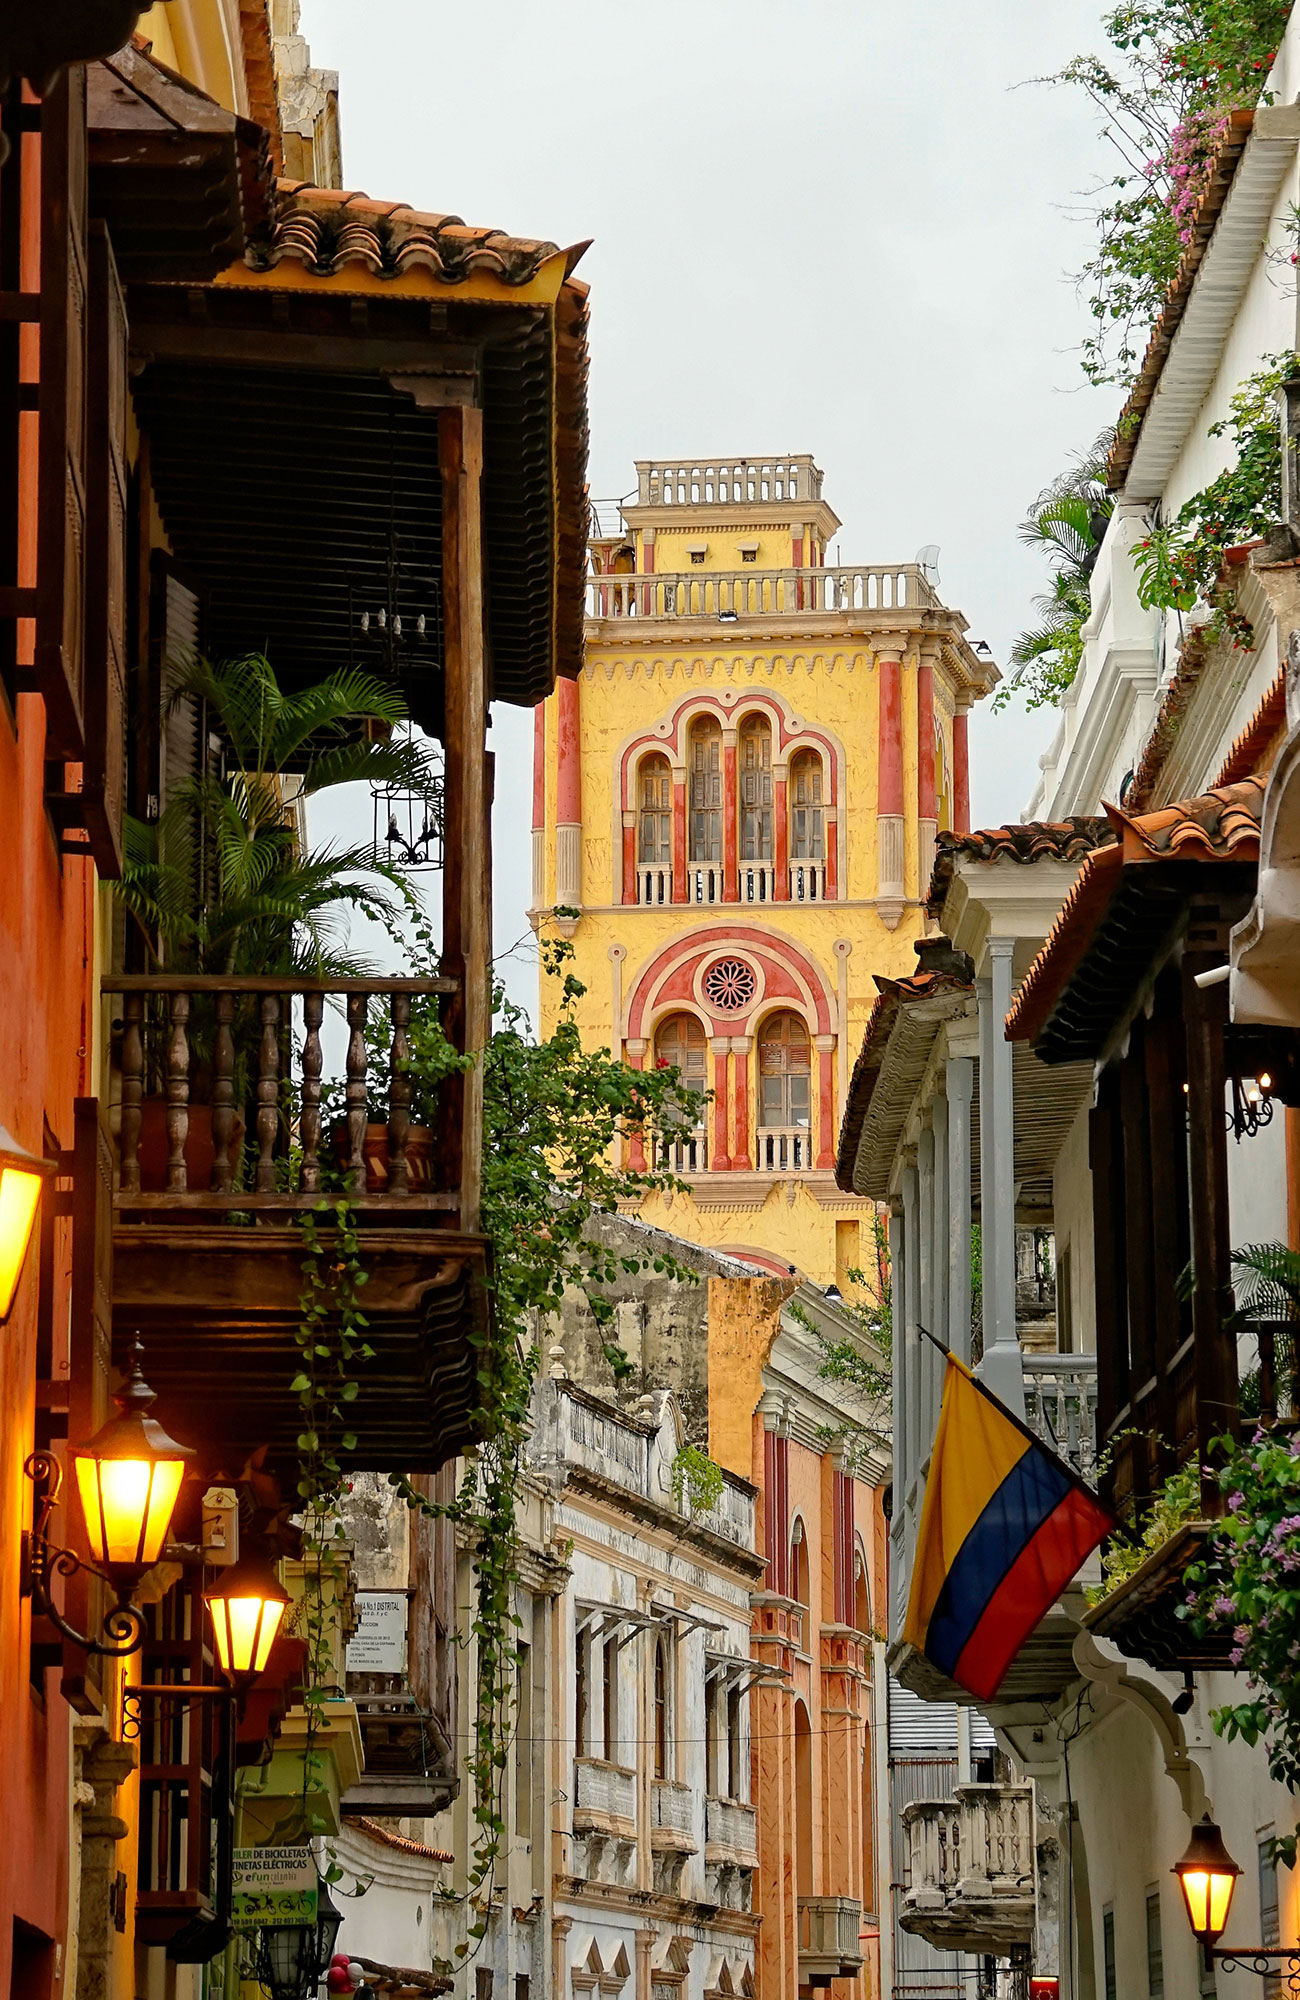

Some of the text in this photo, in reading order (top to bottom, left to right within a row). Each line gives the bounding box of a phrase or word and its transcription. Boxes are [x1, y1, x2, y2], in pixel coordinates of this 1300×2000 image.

[377, 1602, 399, 1610] DISTRITAL
[254, 1850, 263, 1859] DE
[264, 1849, 306, 1859] BICICLETAS
[263, 1858, 307, 1869] ELÉCTRICAS
